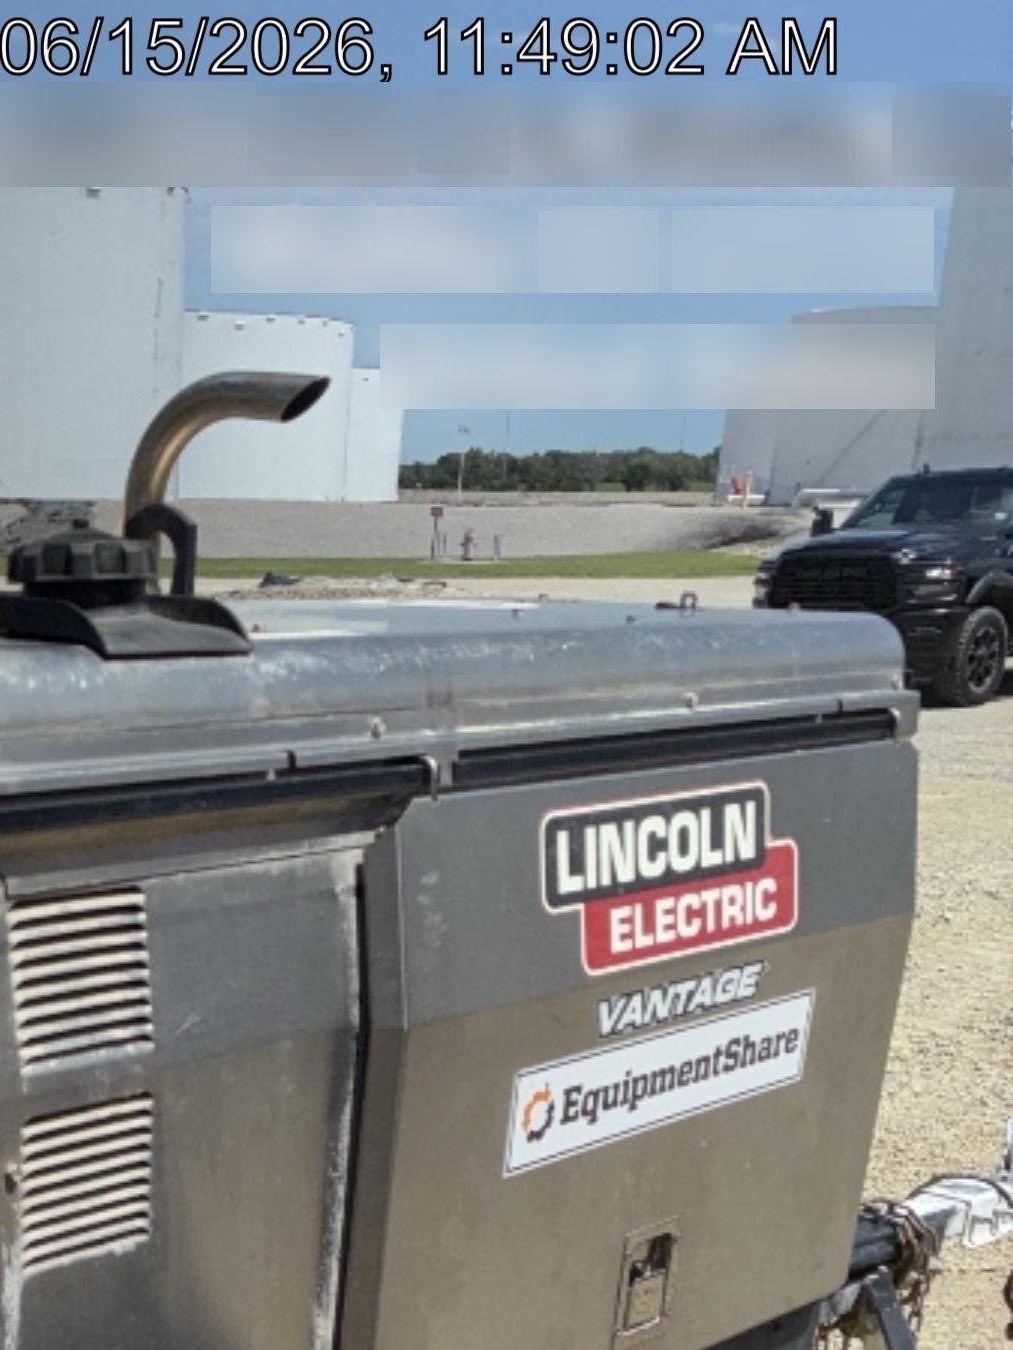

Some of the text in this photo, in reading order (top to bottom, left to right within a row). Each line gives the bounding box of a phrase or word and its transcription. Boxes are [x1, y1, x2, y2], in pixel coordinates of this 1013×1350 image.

[556, 800, 757, 895] LINCOLN
[610, 877, 778, 954] ELECTRIC
[597, 961, 765, 1037] VANTAGE
[560, 1028, 799, 1125] EquipmentShare
